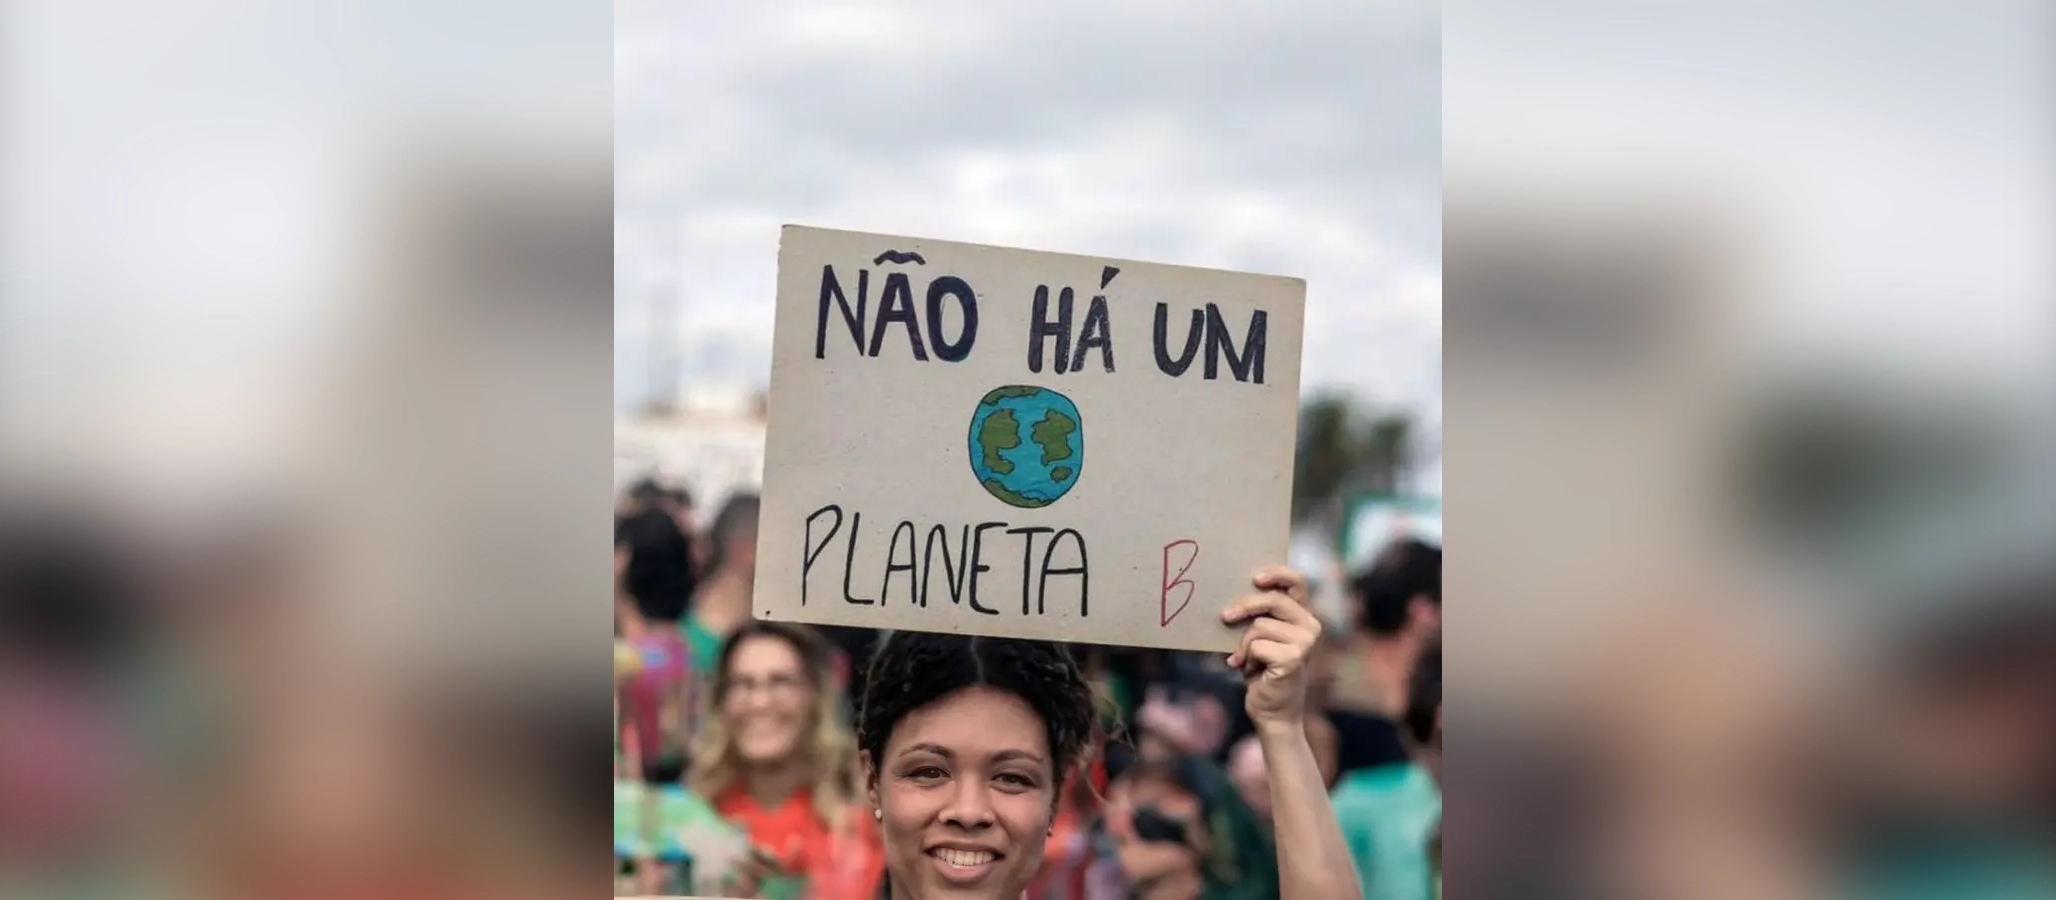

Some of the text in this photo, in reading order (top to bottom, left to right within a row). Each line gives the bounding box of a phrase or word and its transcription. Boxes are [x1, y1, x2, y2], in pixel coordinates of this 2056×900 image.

[815, 249, 1268, 385] NÃO HÁ UM
[801, 504, 1199, 628] PLANETA B
